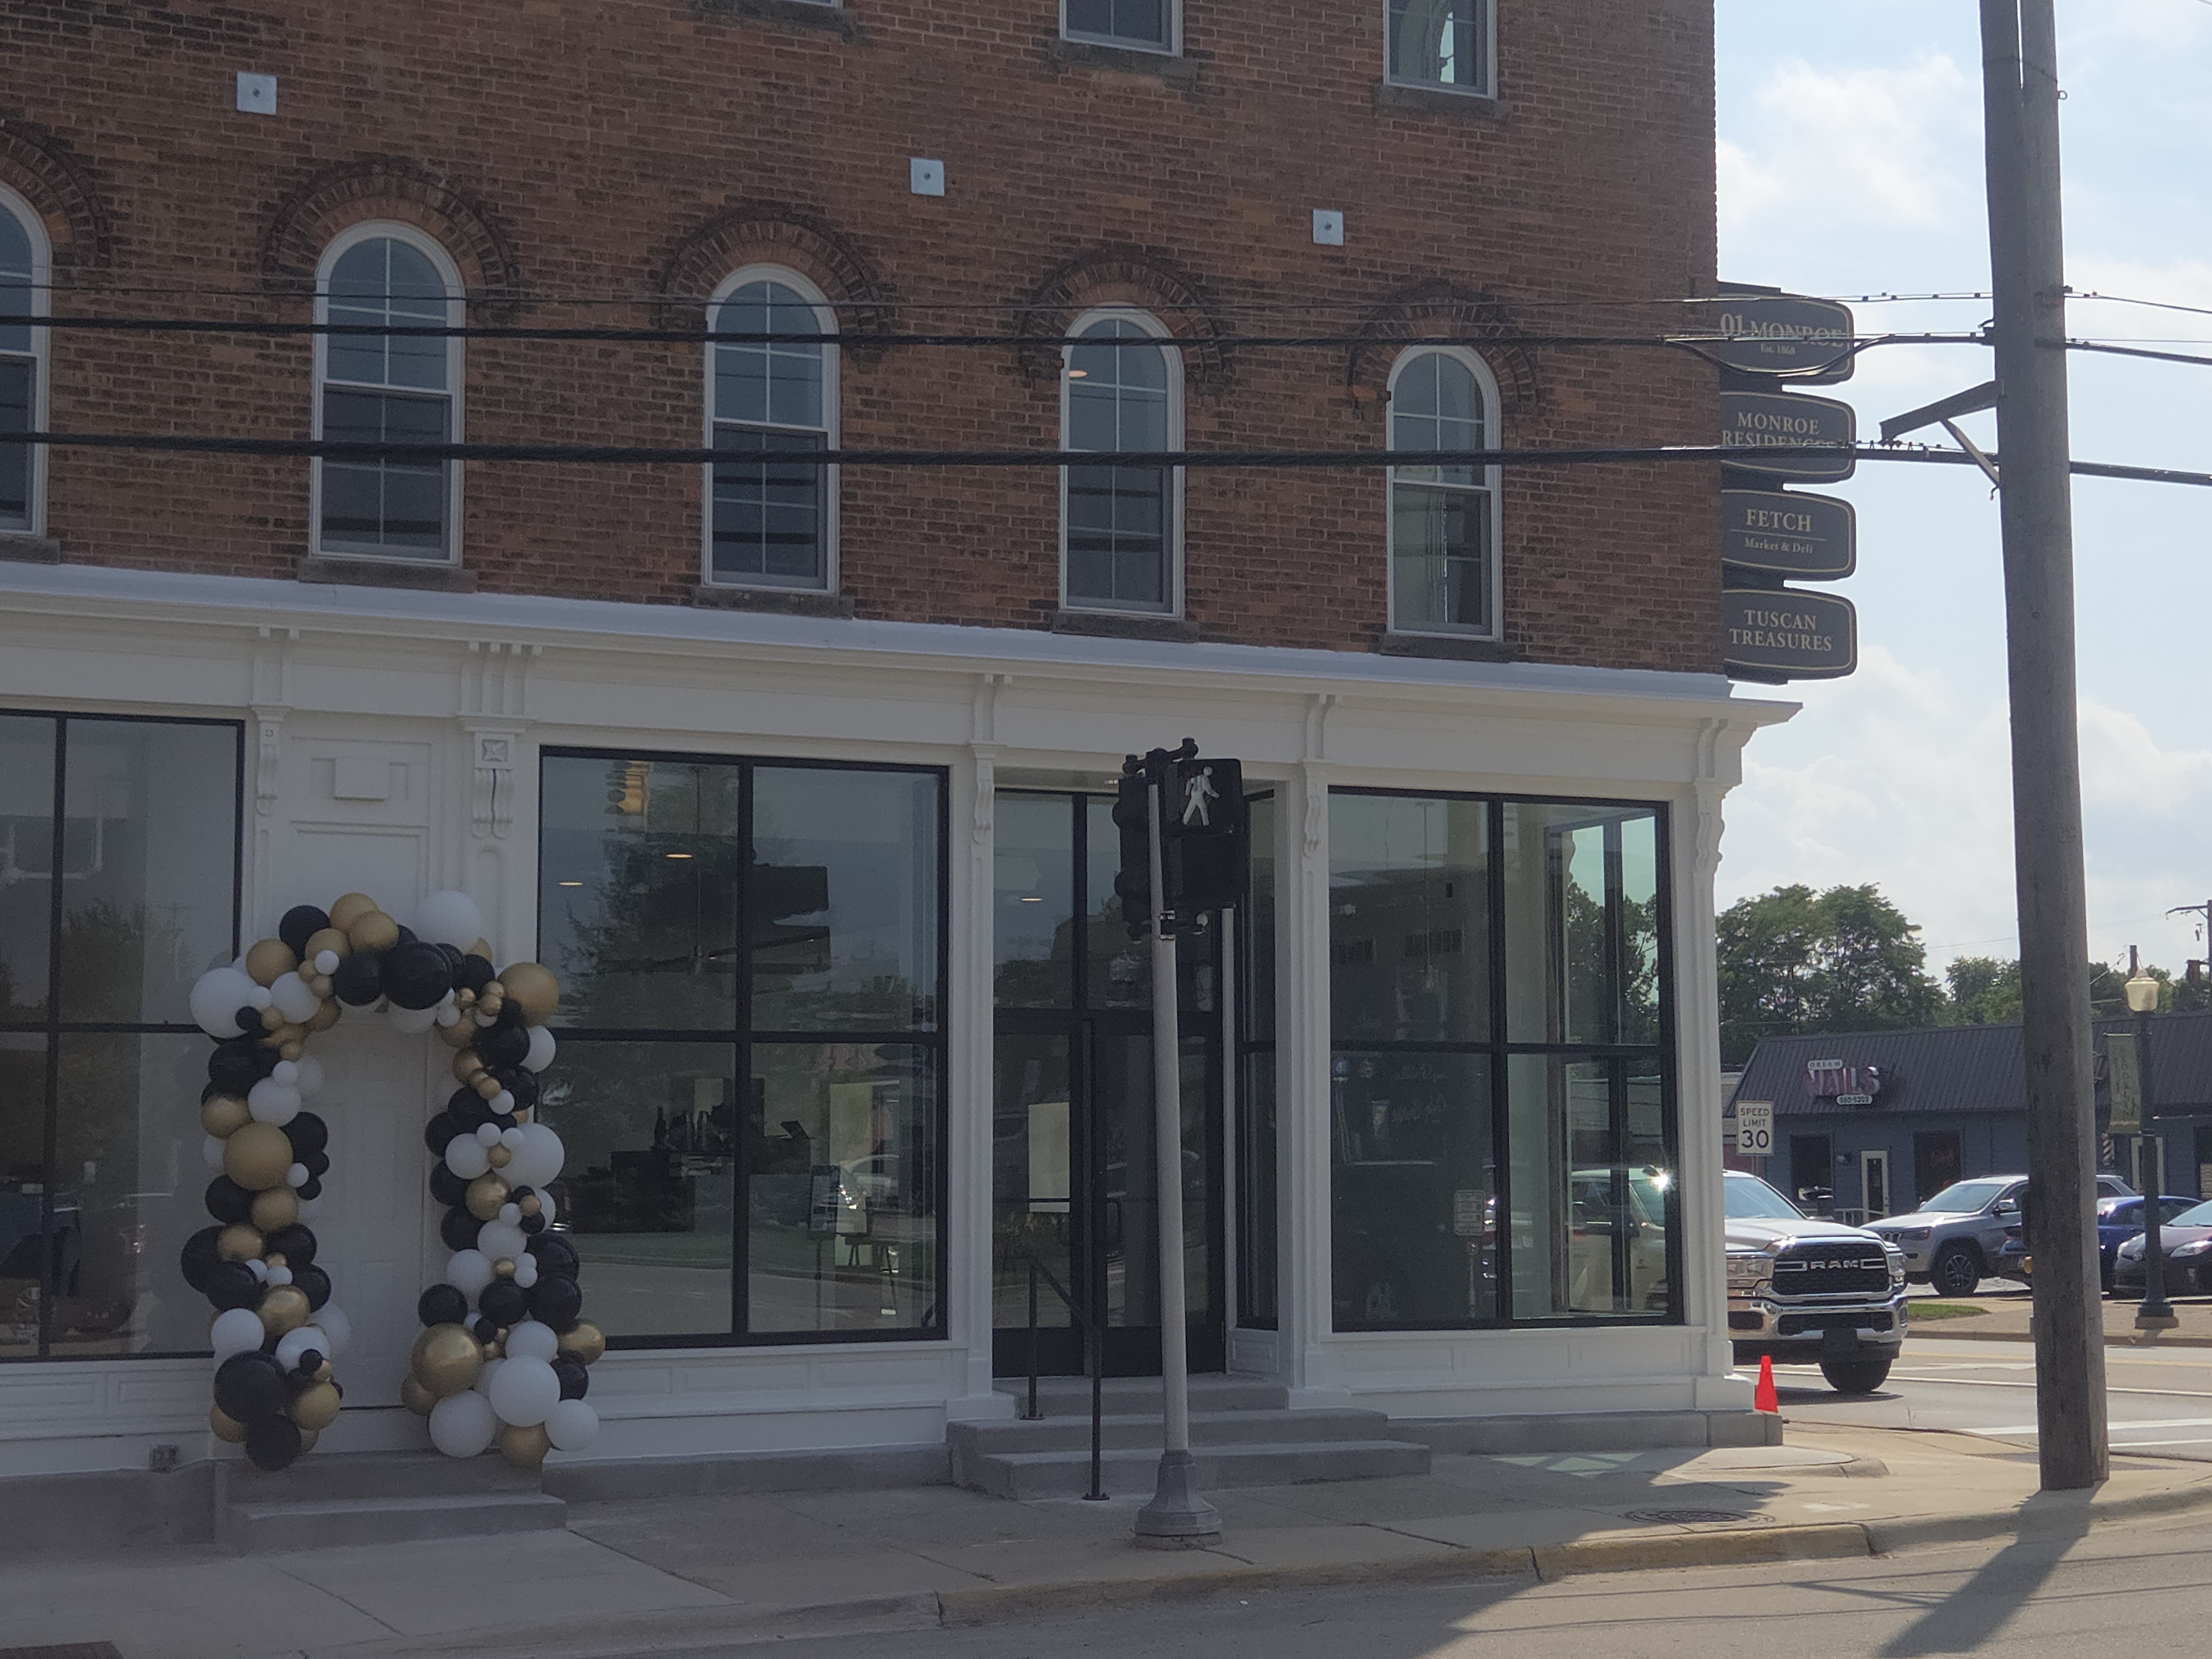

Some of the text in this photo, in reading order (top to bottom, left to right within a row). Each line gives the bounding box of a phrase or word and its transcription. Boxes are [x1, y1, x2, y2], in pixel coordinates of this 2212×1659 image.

[1750, 320, 1844, 347] MONROE
[1737, 412, 1819, 435] MONROE
[1721, 430, 1837, 447] RESIDEN
[1746, 509, 1812, 532] FETCH
[1744, 538, 1778, 551] Market
[1781, 542, 1790, 552] &
[1744, 609, 1817, 631] TUSCAN
[1729, 628, 1832, 651] TREASURES
[1804, 1066, 1880, 1095] NAILS
[1740, 1108, 1770, 1117] SPEED
[1743, 1119, 1766, 1128] LIMIT
[1741, 1129, 1769, 1149] 30
[1810, 1260, 1859, 1270] RAM
